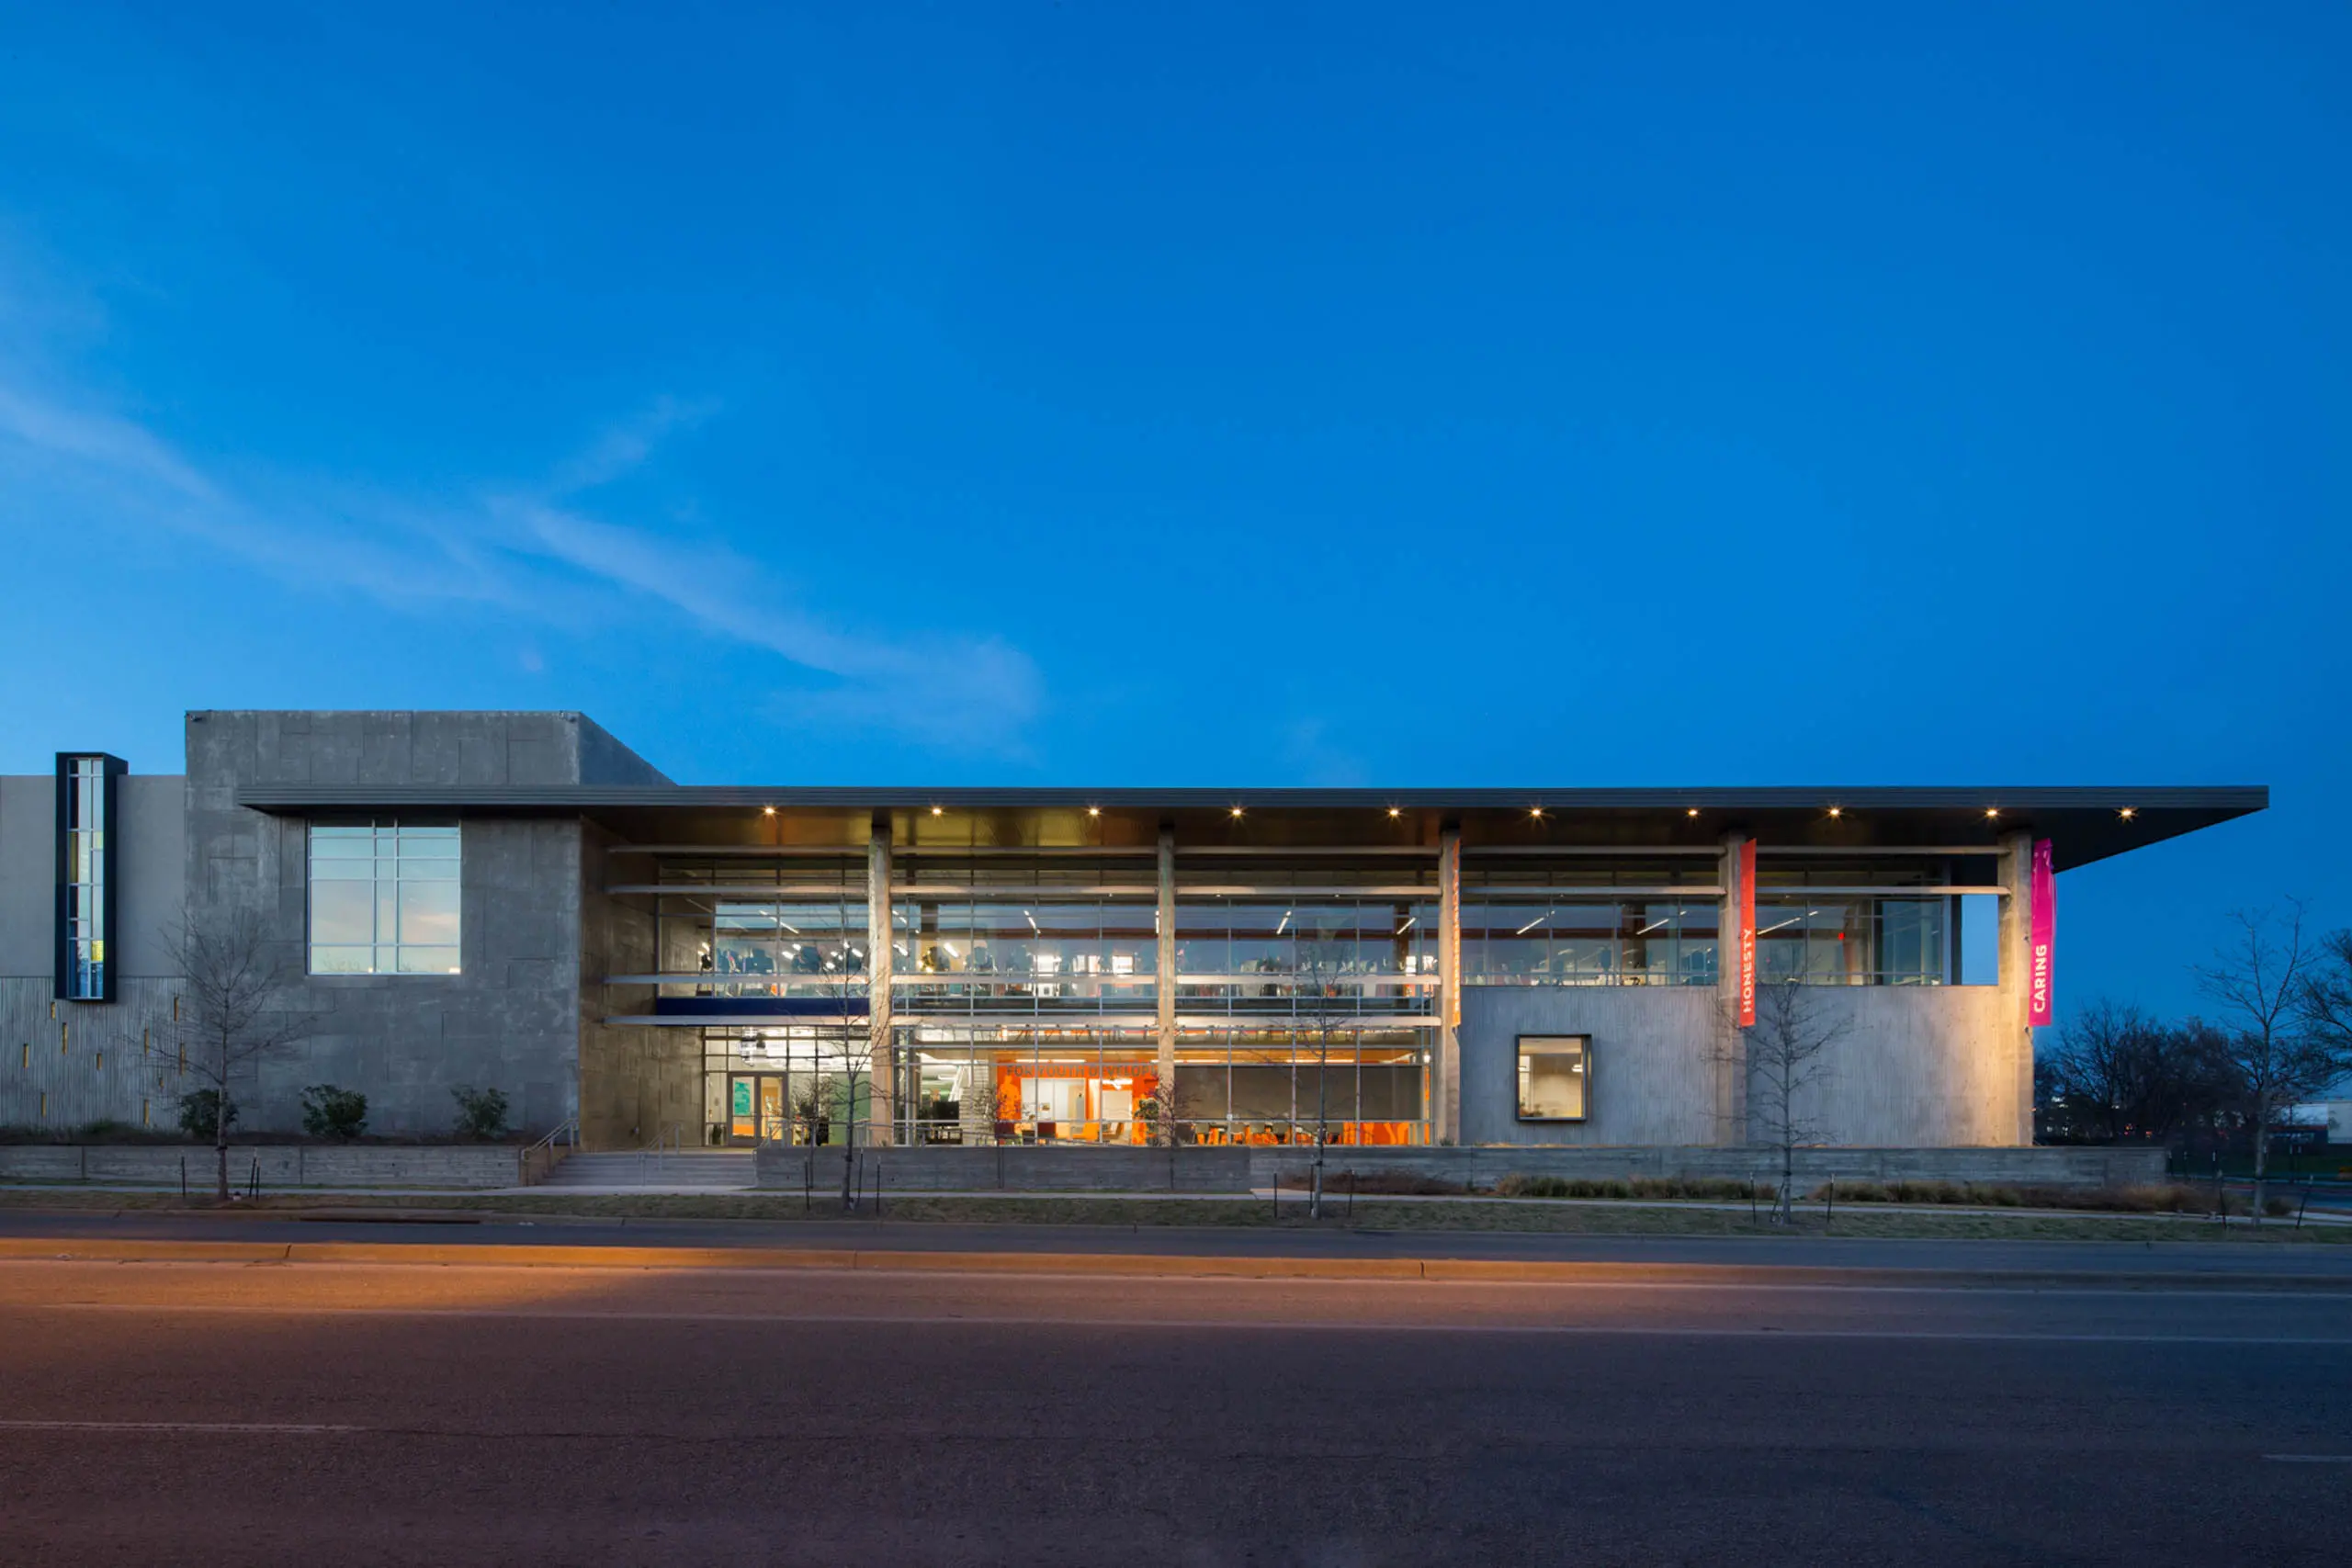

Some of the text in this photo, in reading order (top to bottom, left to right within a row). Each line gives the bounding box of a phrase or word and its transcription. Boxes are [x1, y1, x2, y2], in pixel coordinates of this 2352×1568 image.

[1743, 929, 1752, 1013] HONESTY
[2033, 944, 2047, 1013] CARING
[1007, 1065, 1033, 1077] FOR
[1038, 1065, 1084, 1077] YOUTH
